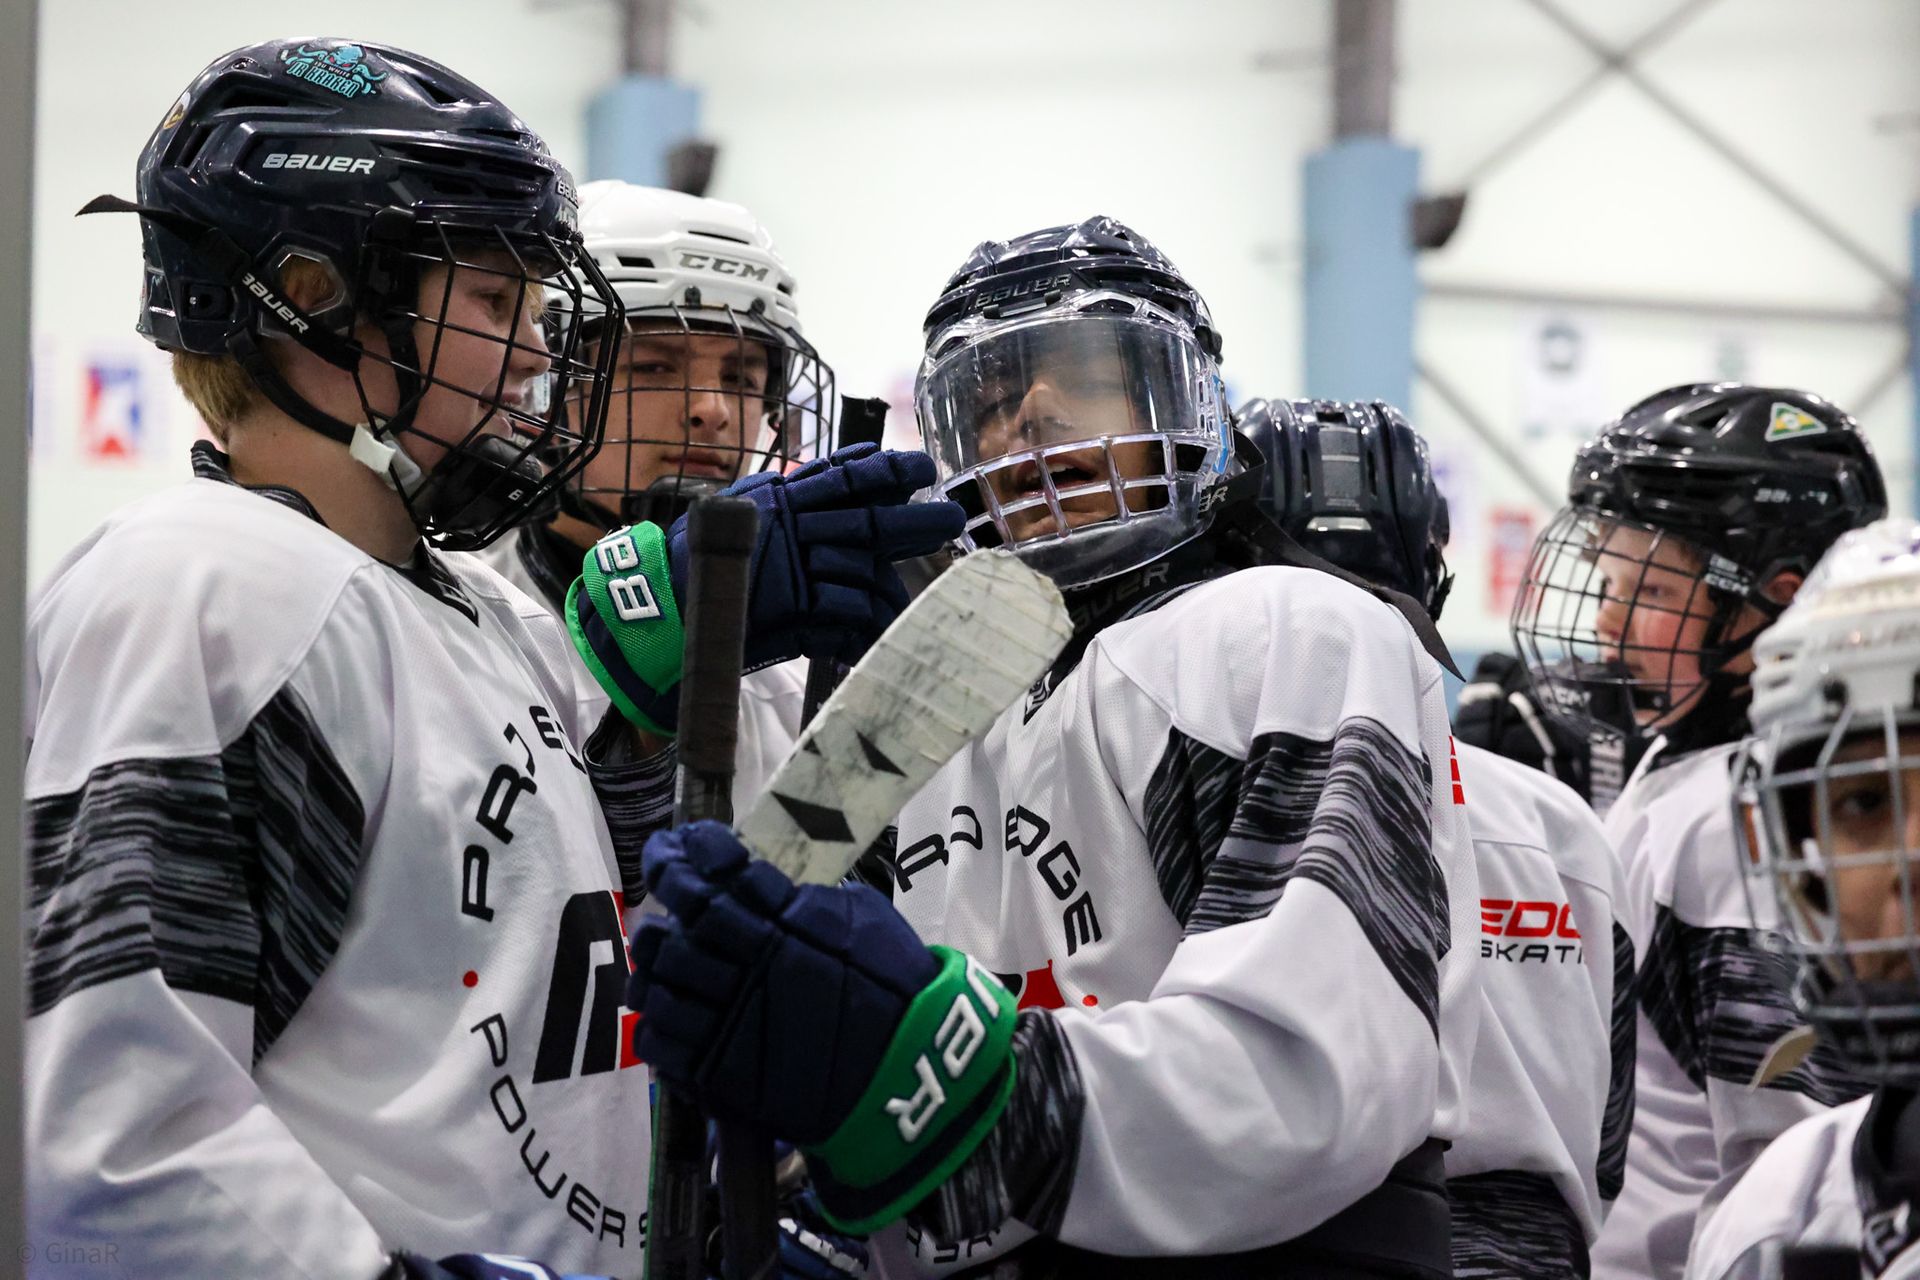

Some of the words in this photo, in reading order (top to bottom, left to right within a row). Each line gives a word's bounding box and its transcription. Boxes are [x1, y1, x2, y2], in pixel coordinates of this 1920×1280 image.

[304, 66, 360, 98] KRAKEN
[262, 152, 376, 175] BAUER
[678, 252, 769, 282] CCM
[975, 273, 1072, 309] BAUER
[1481, 940, 1583, 964] SKATI
[885, 954, 1005, 1142] UER
[470, 1013, 627, 1249] POWER
